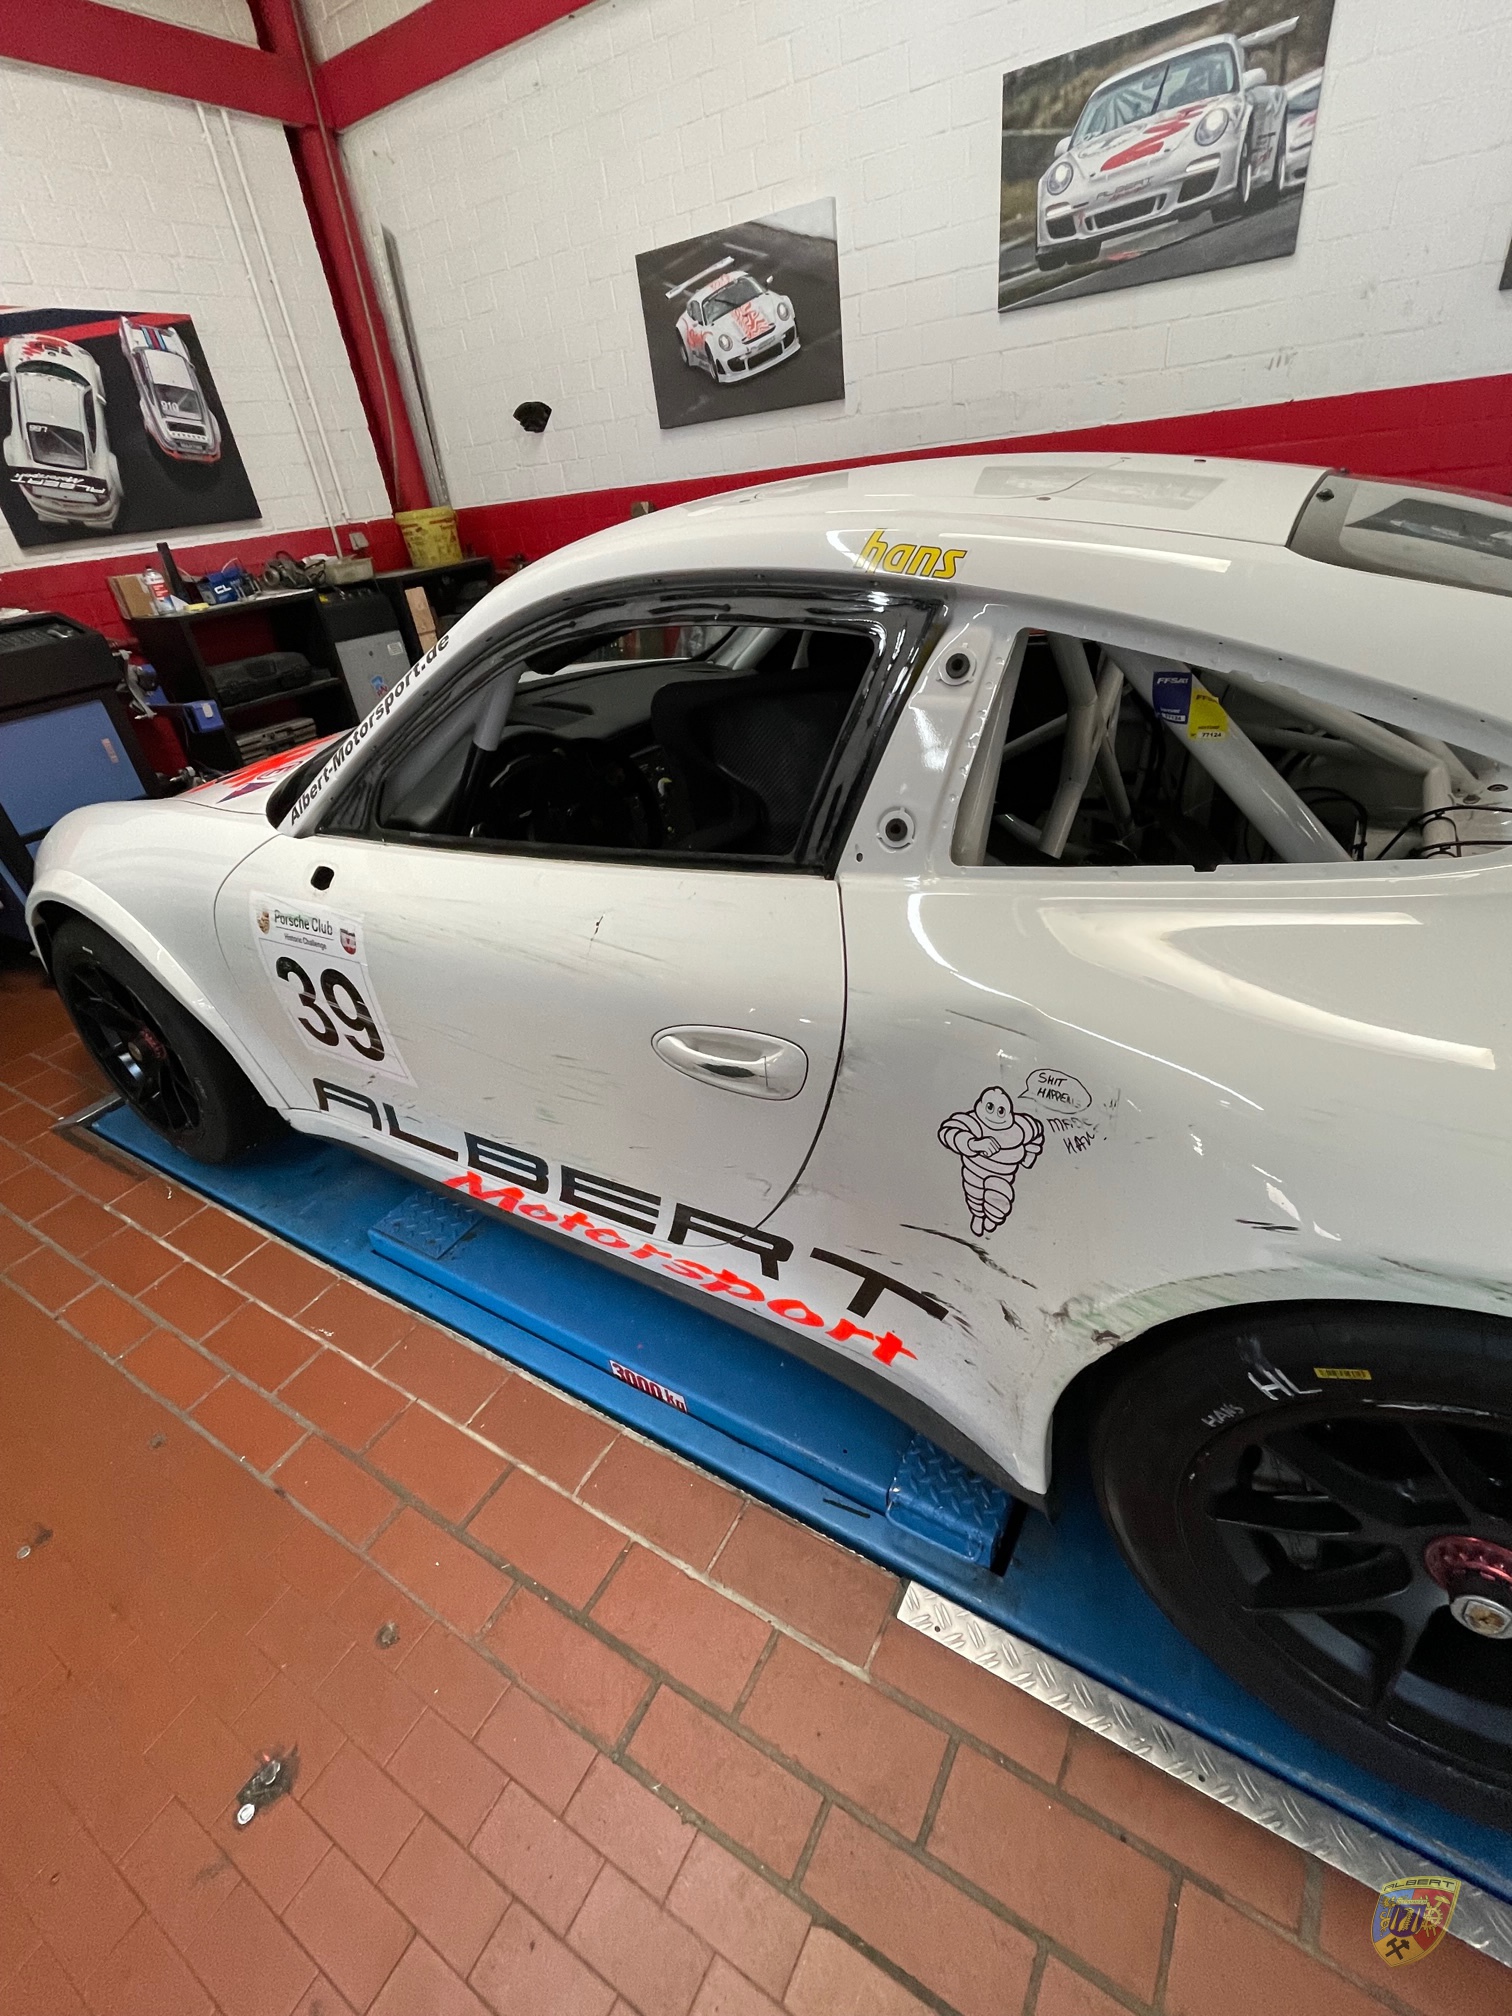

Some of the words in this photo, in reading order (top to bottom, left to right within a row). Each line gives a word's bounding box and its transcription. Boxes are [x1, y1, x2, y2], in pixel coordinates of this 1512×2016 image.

[853, 527, 968, 579] hans
[290, 634, 450, 826] Albert-Motorsport.de
[274, 909, 310, 931] Porsche
[311, 917, 333, 936] Club
[276, 956, 385, 1062] 39
[1038, 1072, 1068, 1087] SHIT
[313, 1077, 950, 1321] ALBERT
[442, 1170, 918, 1368] Motorsport
[612, 1362, 664, 1400] 3000
[1247, 1367, 1323, 1401] HL
[1200, 1402, 1245, 1428] HANS
